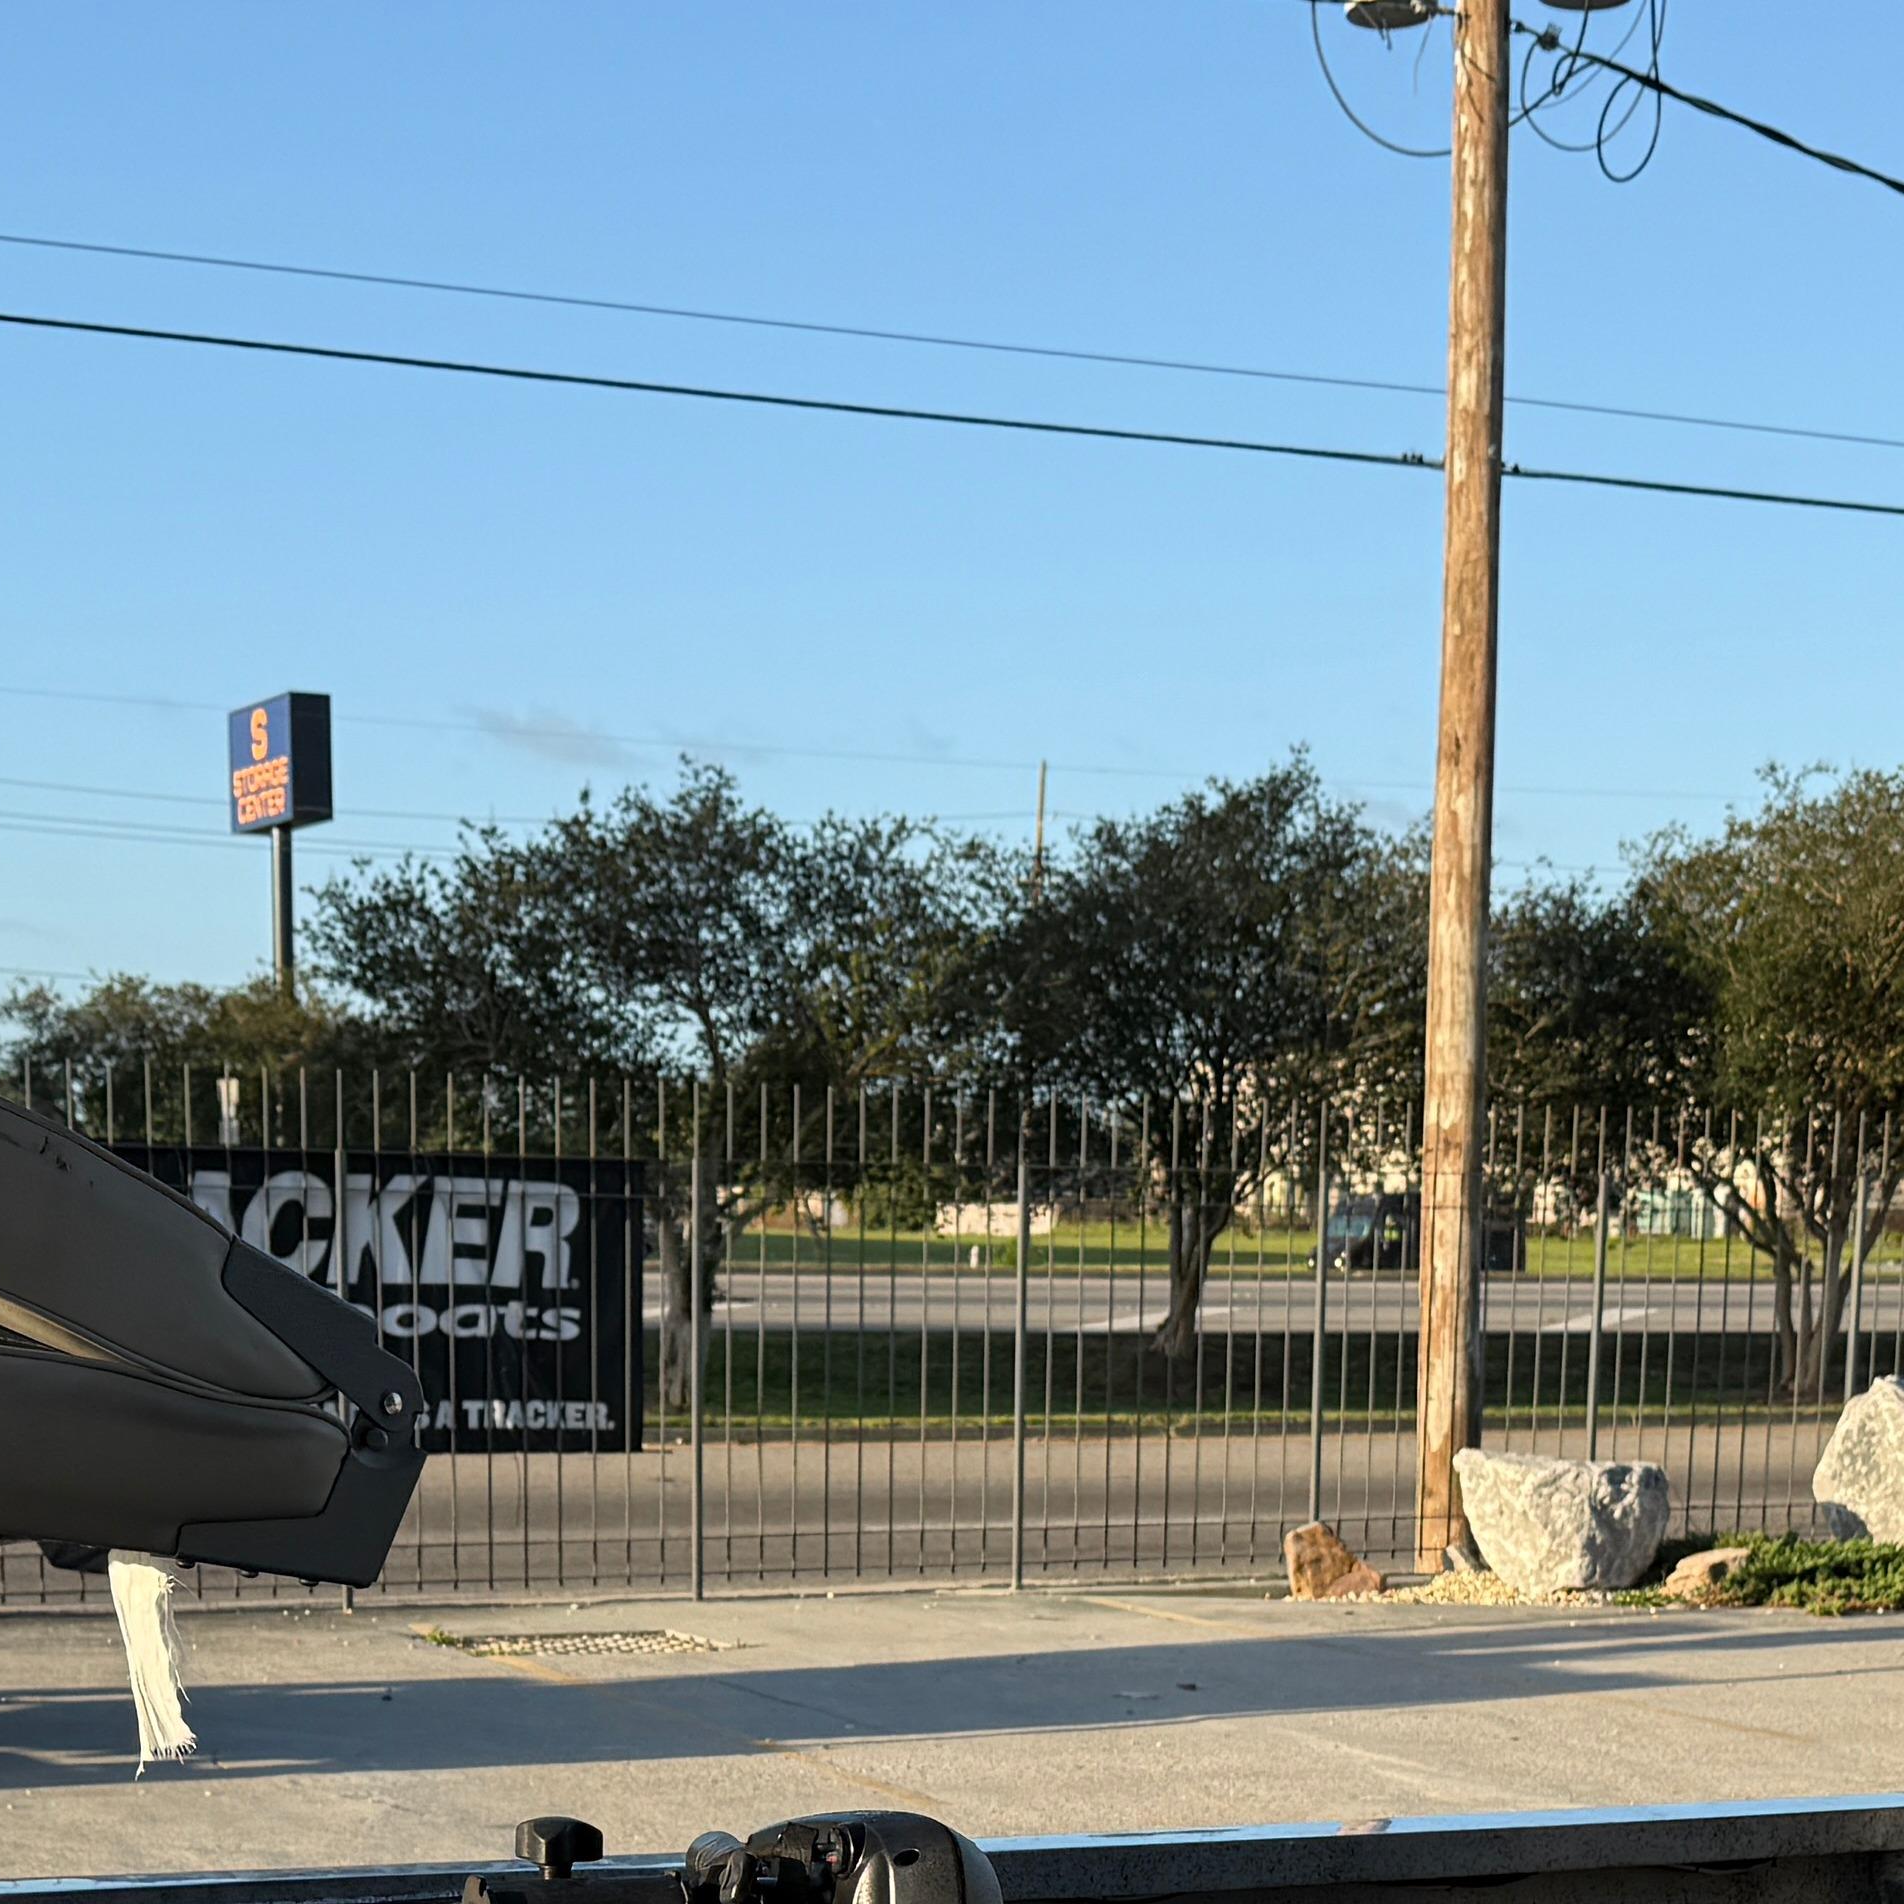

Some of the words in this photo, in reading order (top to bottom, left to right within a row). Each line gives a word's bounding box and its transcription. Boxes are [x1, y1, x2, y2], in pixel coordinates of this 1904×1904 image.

[250, 708, 268, 761] S
[348, 1300, 581, 1341] oats
[462, 1399, 616, 1431] TRACKER.
